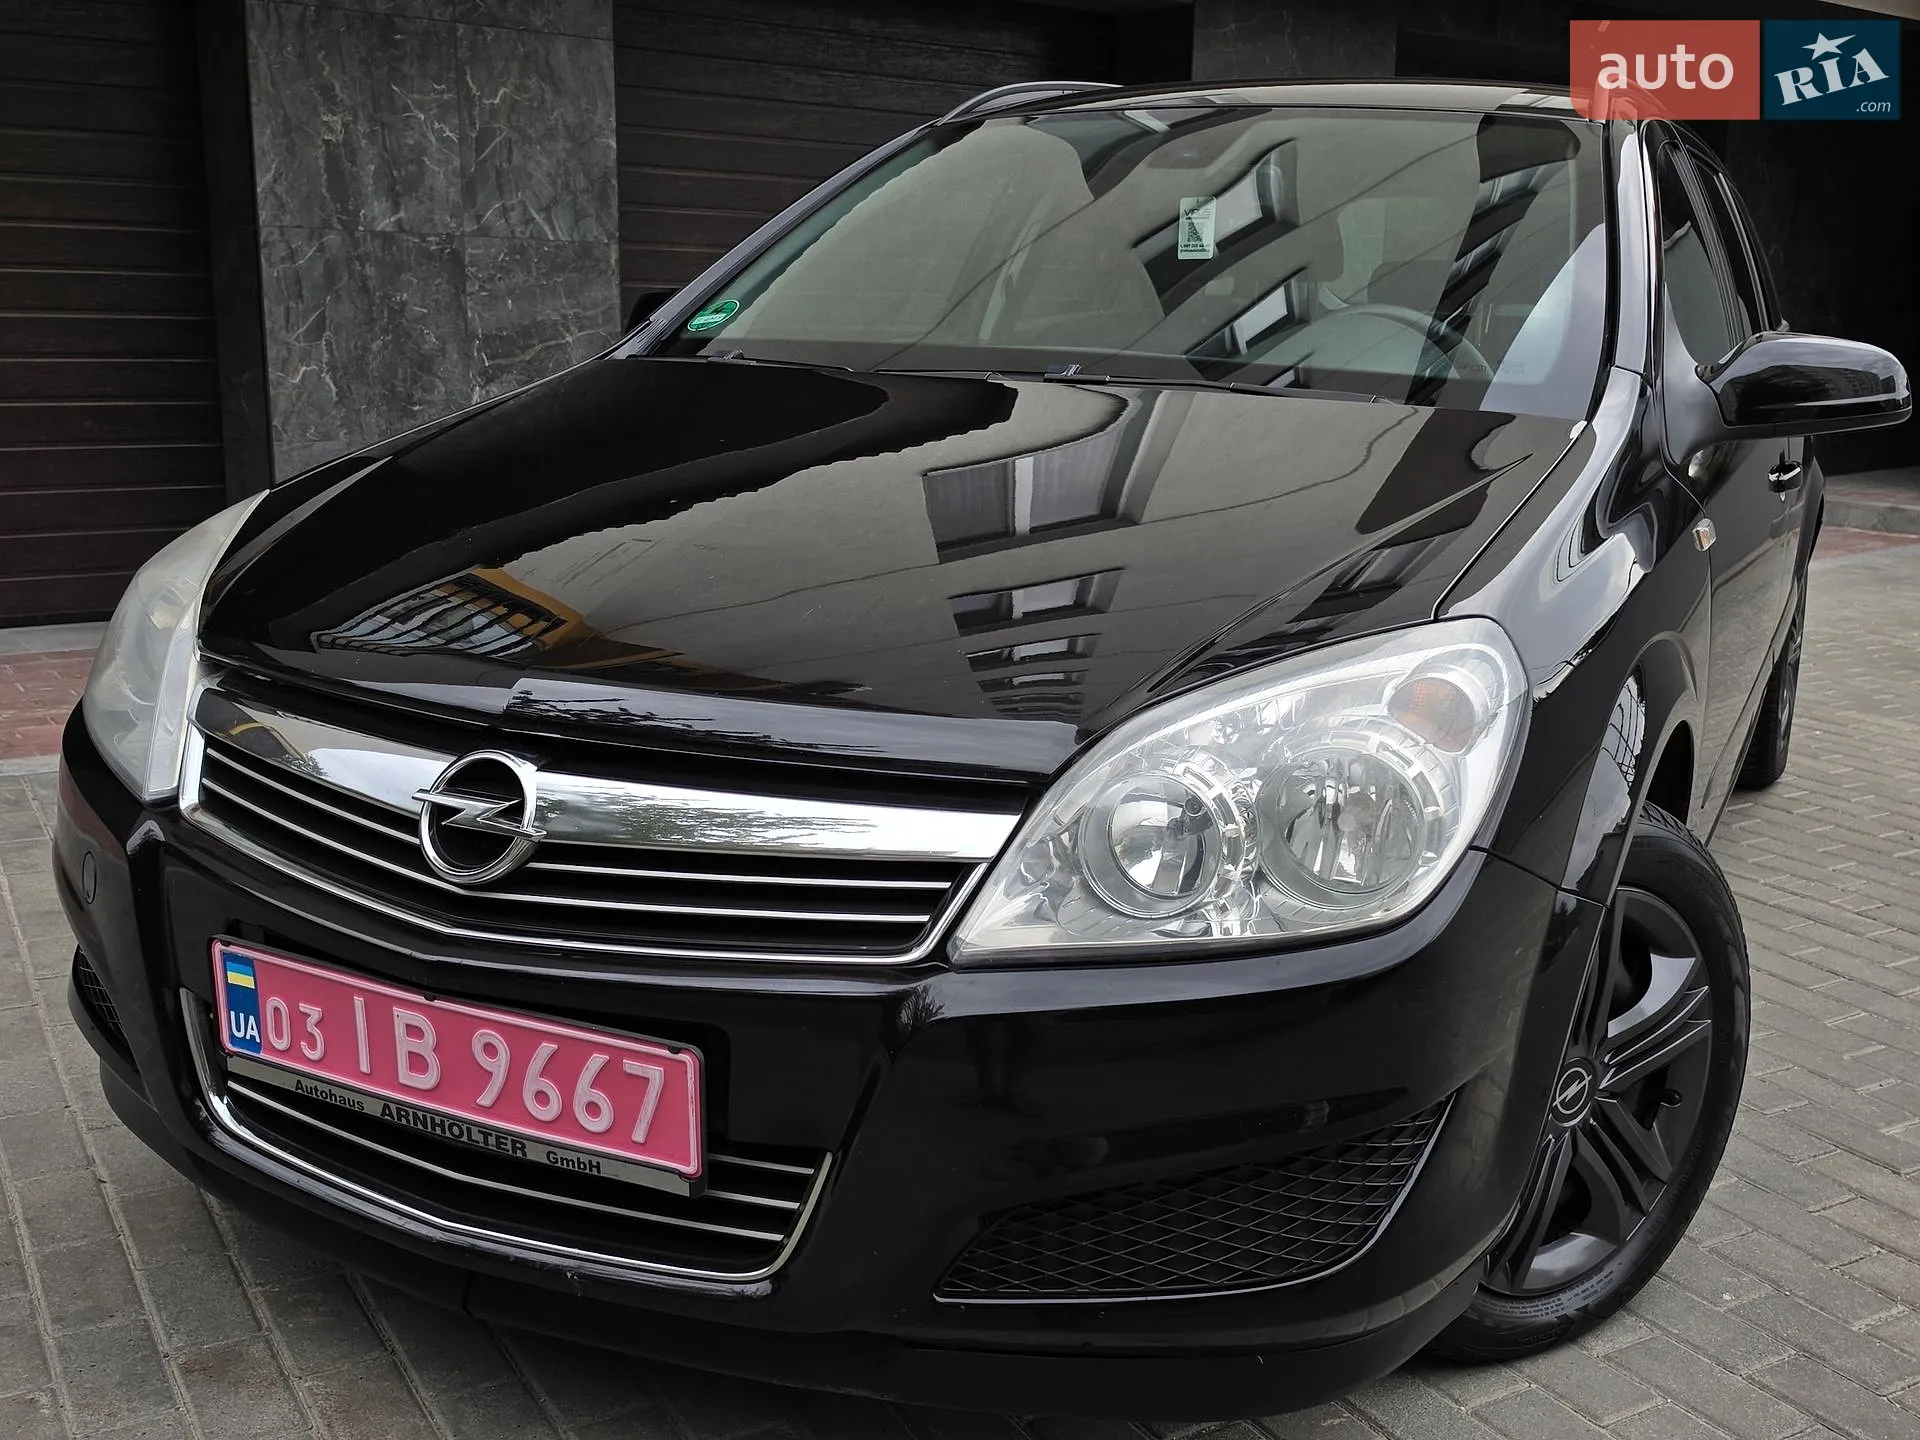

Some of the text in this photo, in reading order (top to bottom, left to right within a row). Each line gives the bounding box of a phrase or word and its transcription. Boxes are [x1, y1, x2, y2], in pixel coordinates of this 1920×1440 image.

[230, 1011, 261, 1043] UA
[265, 995, 665, 1145] 03 IB 9667
[294, 1079, 366, 1111] Autohaus
[545, 1150, 602, 1175] GmbH
